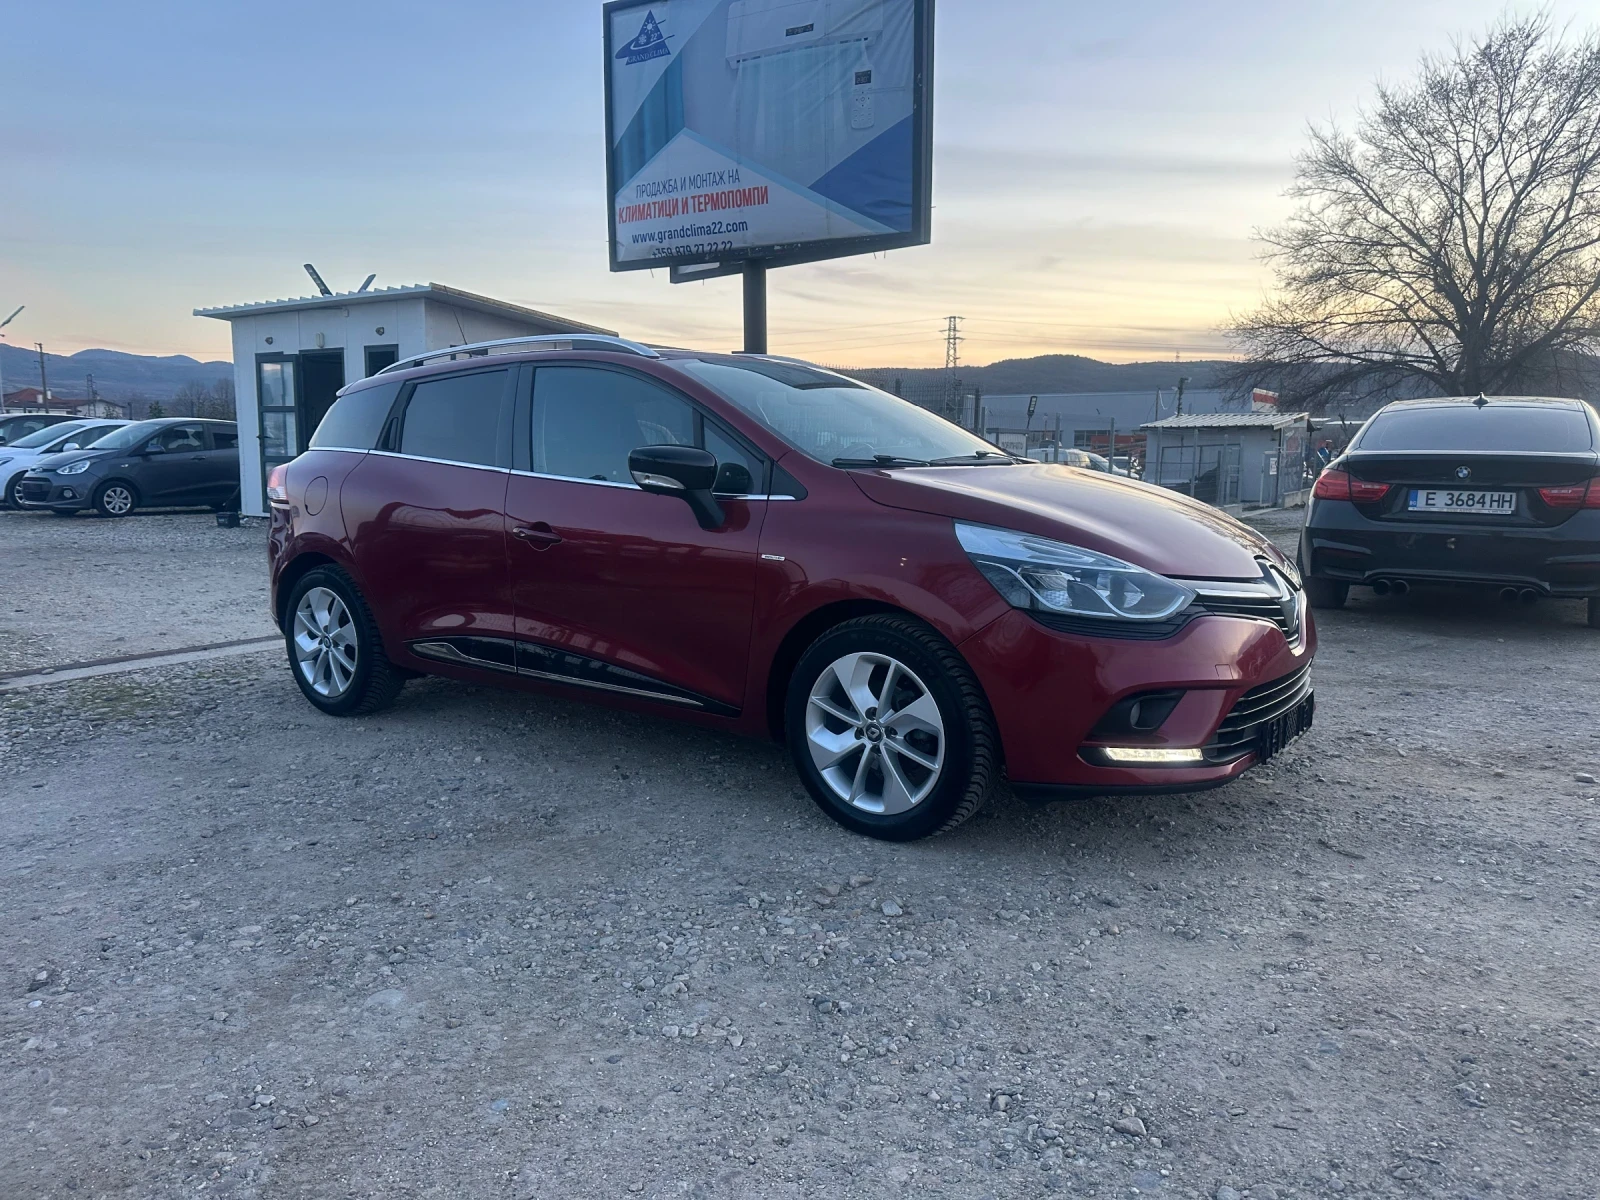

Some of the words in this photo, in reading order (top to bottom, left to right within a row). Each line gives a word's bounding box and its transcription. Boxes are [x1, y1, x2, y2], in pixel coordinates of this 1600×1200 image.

[636, 178, 678, 199] ПРОДАЖБА
[680, 176, 687, 191] И
[689, 171, 726, 190] МОНТАЖ
[728, 168, 740, 184] НА
[618, 197, 679, 224] КЛИМАТИЦИ
[681, 196, 688, 215] И
[691, 186, 769, 213] ТЕРМОПОМПИ
[632, 220, 748, 244] www.grandclima22.com
[1425, 492, 1436, 506] E
[1444, 492, 1486, 508] 3684
[1489, 493, 1513, 509] HH
